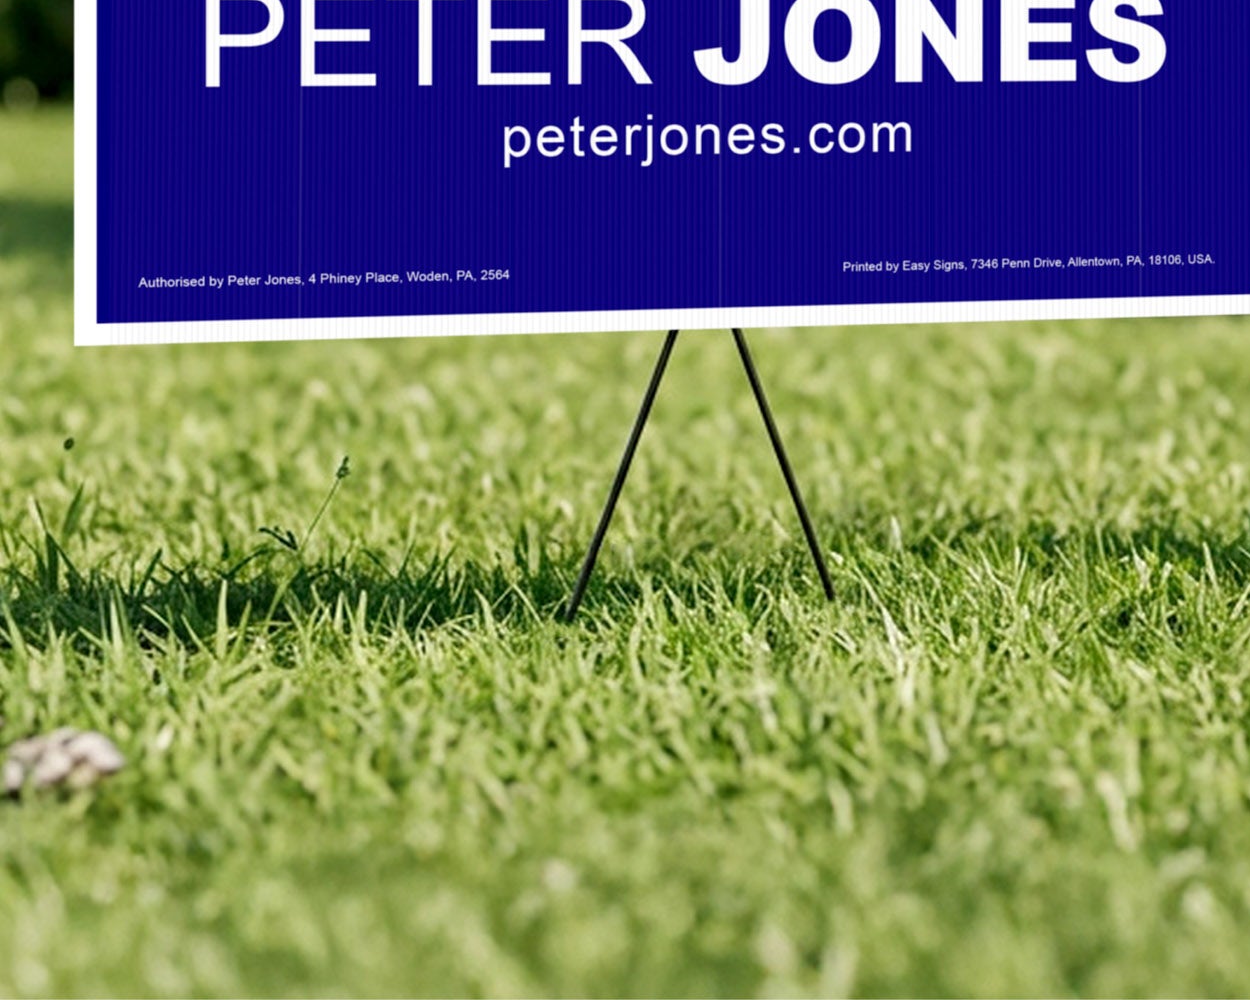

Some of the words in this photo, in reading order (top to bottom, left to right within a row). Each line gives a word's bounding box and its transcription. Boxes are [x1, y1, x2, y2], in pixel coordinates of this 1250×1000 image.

[503, 113, 912, 168] peterjones.com
[842, 261, 883, 272] Printed
[885, 261, 900, 274] by
[902, 259, 931, 273] Easy
[933, 259, 968, 273] Signs,
[971, 258, 999, 270] 7346
[1001, 257, 1031, 269] Penn
[1033, 257, 1065, 269] Drive,
[1067, 256, 1123, 268] Allentown,
[1126, 255, 1145, 267] PA,
[1149, 254, 1185, 266] 18106,
[1187, 253, 1215, 265] USA.
[138, 275, 206, 288] Authorised
[208, 275, 225, 289] by
[227, 274, 262, 286] Peter
[264, 274, 305, 286] Jones,
[308, 273, 317, 284] 4
[320, 272, 362, 286] Phiney
[365, 271, 403, 284] Place,
[406, 270, 453, 283] Woden,
[456, 269, 477, 282] PA,
[480, 269, 510, 281] 2564
